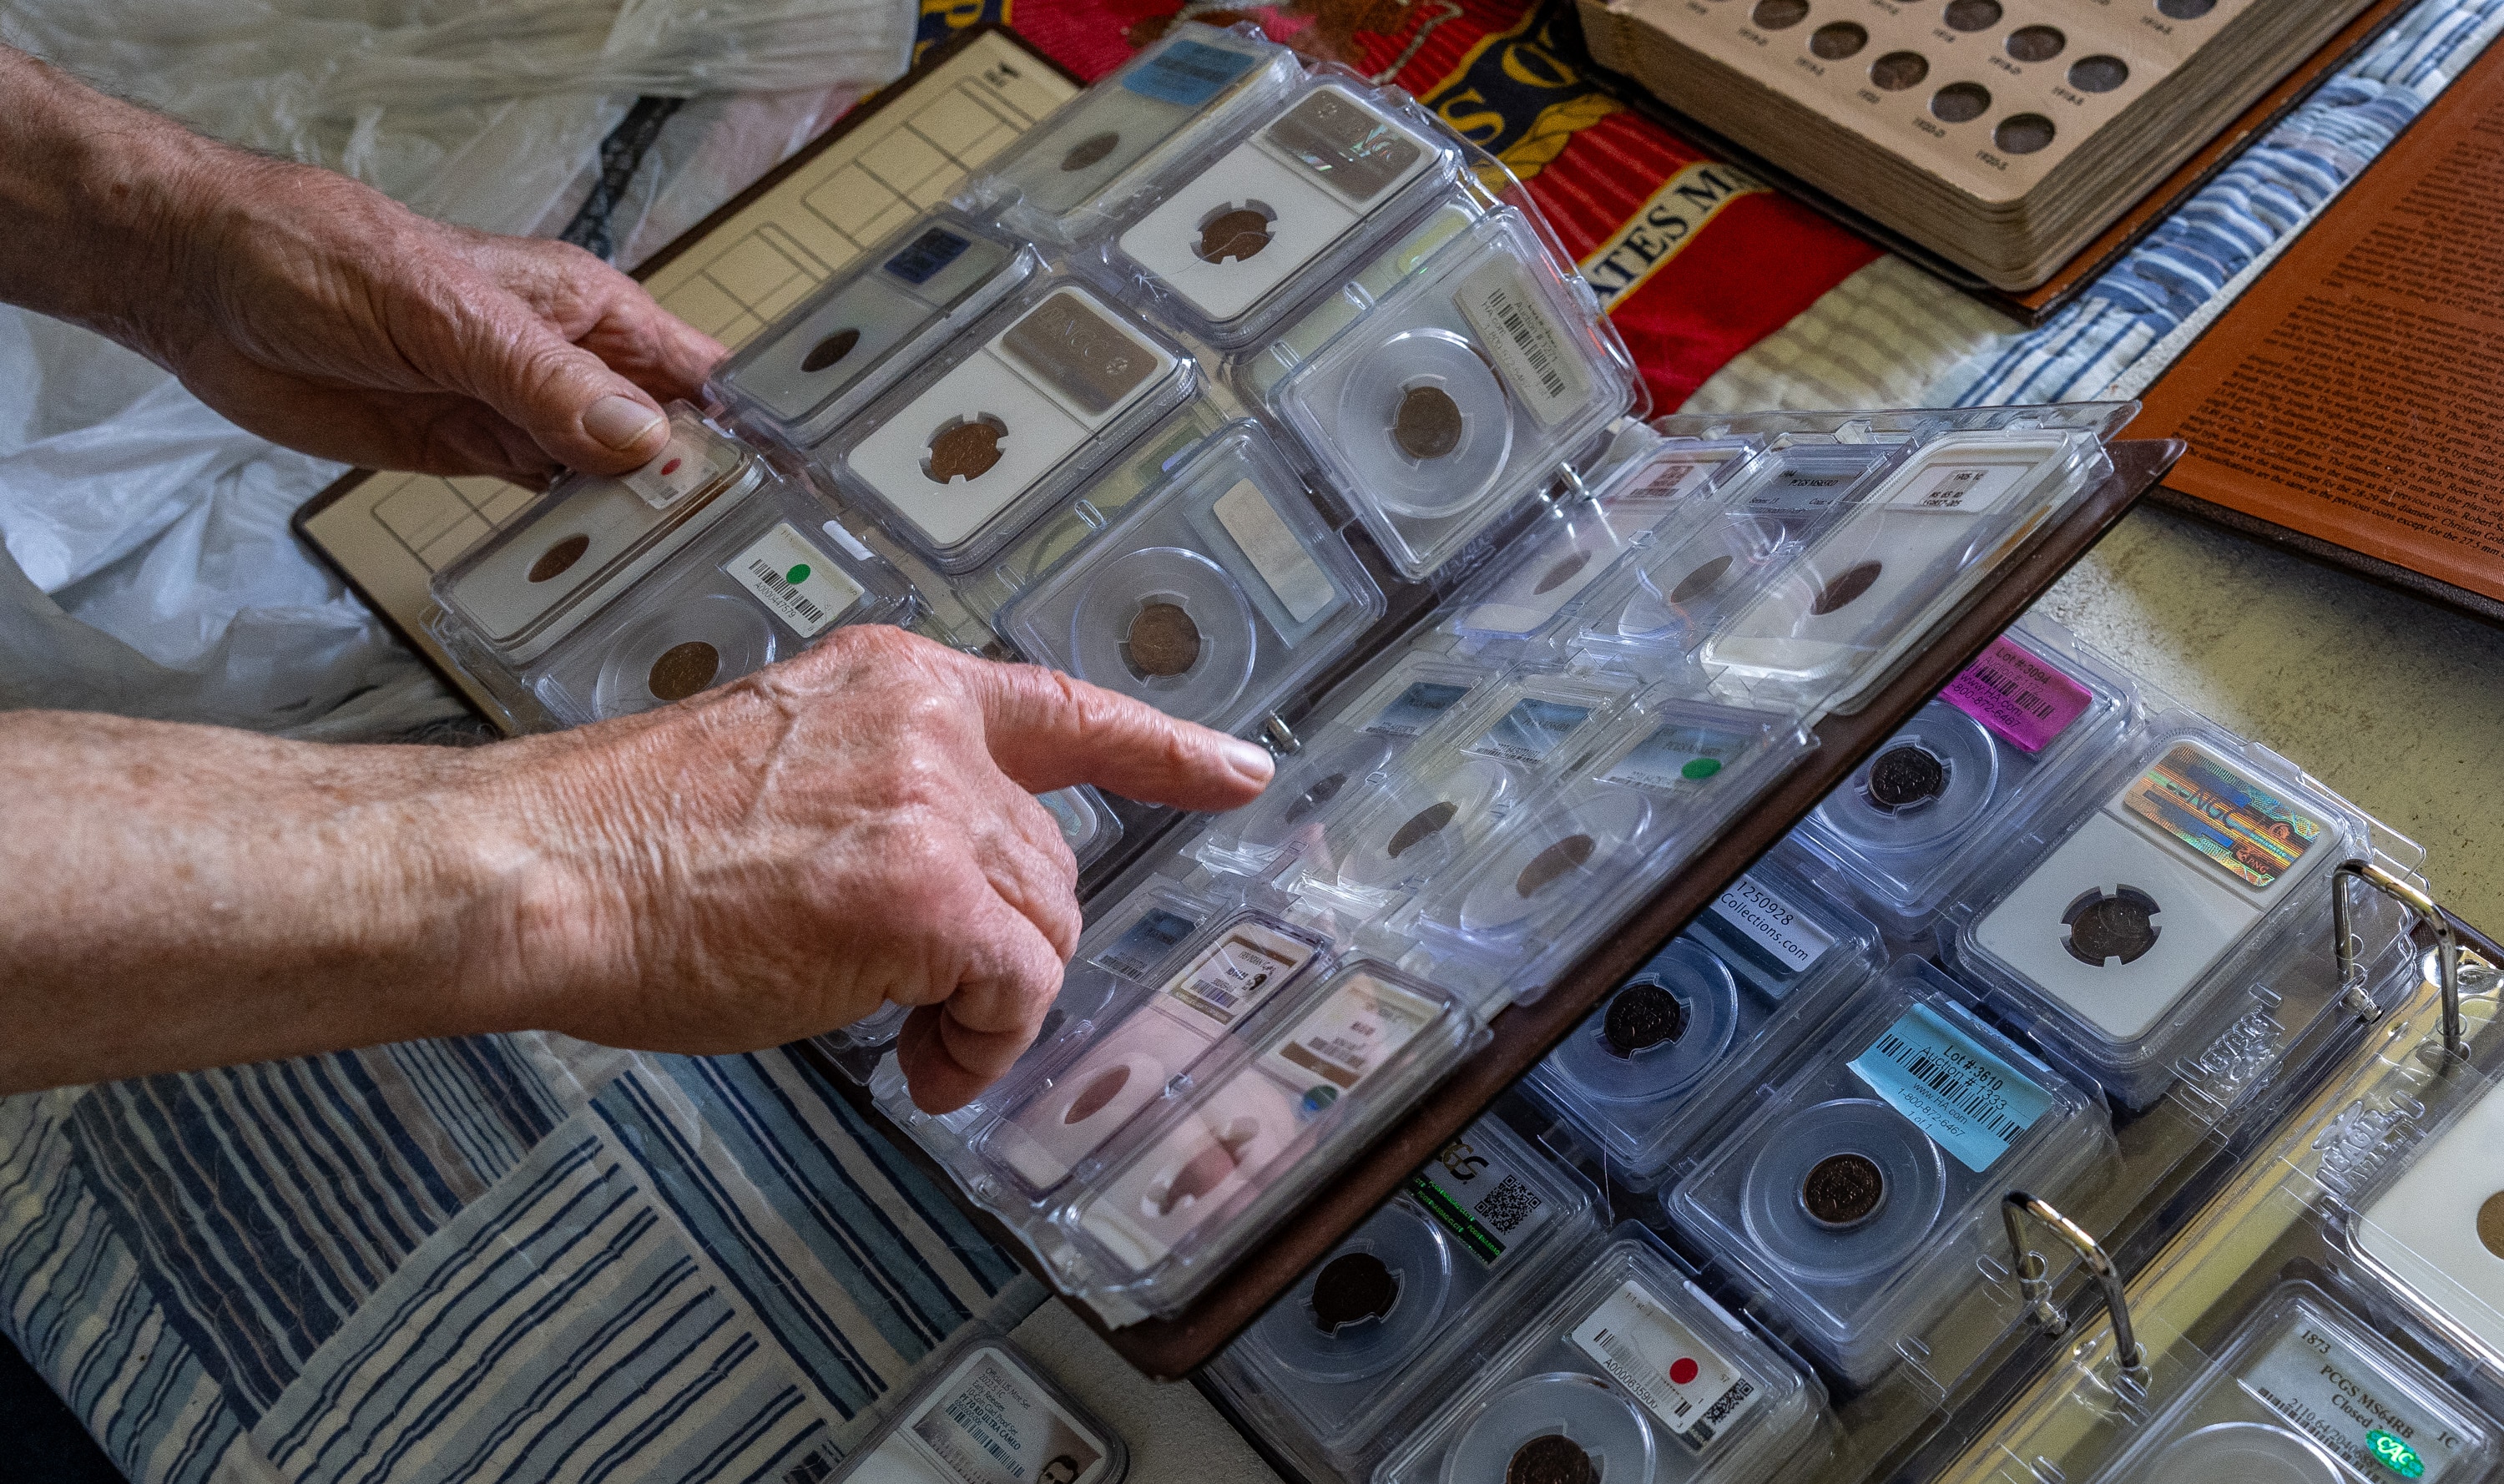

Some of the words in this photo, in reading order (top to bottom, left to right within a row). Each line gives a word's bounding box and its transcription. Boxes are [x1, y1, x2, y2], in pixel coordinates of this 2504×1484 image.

[1591, 203, 1689, 300] ATES
[2370, 447, 2384, 456] the
[2384, 452, 2416, 467] Liberty
[2417, 462, 2437, 474] Cap
[2437, 468, 2458, 481] type
[2459, 475, 2484, 487] made
[2431, 442, 2451, 455] Cap
[2473, 455, 2498, 467] made
[2459, 462, 2498, 480] Hundred
[2255, 457, 2269, 467] the
[2269, 464, 2291, 474] same
[2291, 470, 2321, 485] except
[2322, 479, 2335, 488] for
[2337, 484, 2351, 493] the
[2351, 489, 2379, 502] 28-29
[2379, 499, 2395, 508] mm
[2397, 504, 2439, 522] diameter.
[2441, 517, 2482, 537] Christian
[2484, 532, 2504, 544] Gob
[2326, 469, 2341, 478] the
[2343, 476, 2364, 486] same
[2391, 492, 2431, 509] previous
[2431, 504, 2459, 517] coins.
[2461, 512, 2493, 527] Robert
[2345, 462, 2383, 480] diameter
[2408, 485, 2426, 493] mm
[2427, 489, 2446, 500] and
[2446, 495, 2462, 505] the
[2461, 500, 2487, 515] plain
[2487, 508, 2504, 522] edg
[2447, 483, 2479, 497] Robert
[2271, 475, 2284, 483] the
[2286, 481, 2306, 491] same
[2319, 490, 2333, 499] the
[2332, 496, 2370, 514] previous
[2372, 508, 2395, 520] coins
[2395, 516, 2426, 533] except
[2428, 527, 2441, 536] for
[2443, 532, 2458, 541] the
[2459, 537, 2481, 548] 27.5
[2481, 546, 2499, 555] mm
[1995, 647, 2017, 663] Lot
[1948, 683, 2022, 728] -800-872-6467
[1958, 675, 2024, 715] www.HA.com
[2188, 789, 2240, 830] NGC
[1737, 881, 1794, 926] 1250928
[1717, 891, 1810, 961] Collections.com
[1919, 1045, 1965, 1078] Auction
[1942, 1046, 1967, 1065] Lot
[1896, 1089, 1965, 1137] 1-800-872-6467
[1912, 1084, 1968, 1123] www.HA.com
[2301, 1330, 2330, 1353] 1873
[972, 1380, 985, 1394] Early
[984, 1391, 1005, 1411] Releases
[979, 1373, 992, 1387] 2022
[997, 1390, 1003, 1398] 1C
[1002, 1381, 1010, 1391] US
[1009, 1389, 1022, 1401] Mint
[1021, 1400, 1030, 1410] Set
[2320, 1365, 2360, 1396] PCGS
[2356, 1394, 2416, 1438] MS64RB
[960, 1392, 968, 1402] PF
[967, 1399, 975, 1408] 70
[974, 1406, 983, 1416] RD
[982, 1413, 1000, 1432] ULTRA
[999, 1429, 1020, 1451] CAMEO
[967, 1386, 986, 1406] 10-Coin
[985, 1403, 997, 1416] Clad
[996, 1414, 1010, 1428] Proof
[1008, 1425, 1017, 1436] Set
[2330, 1394, 2373, 1427] Closed
[2374, 1434, 2414, 1468] CAC
[2436, 1431, 2458, 1450] 1C
